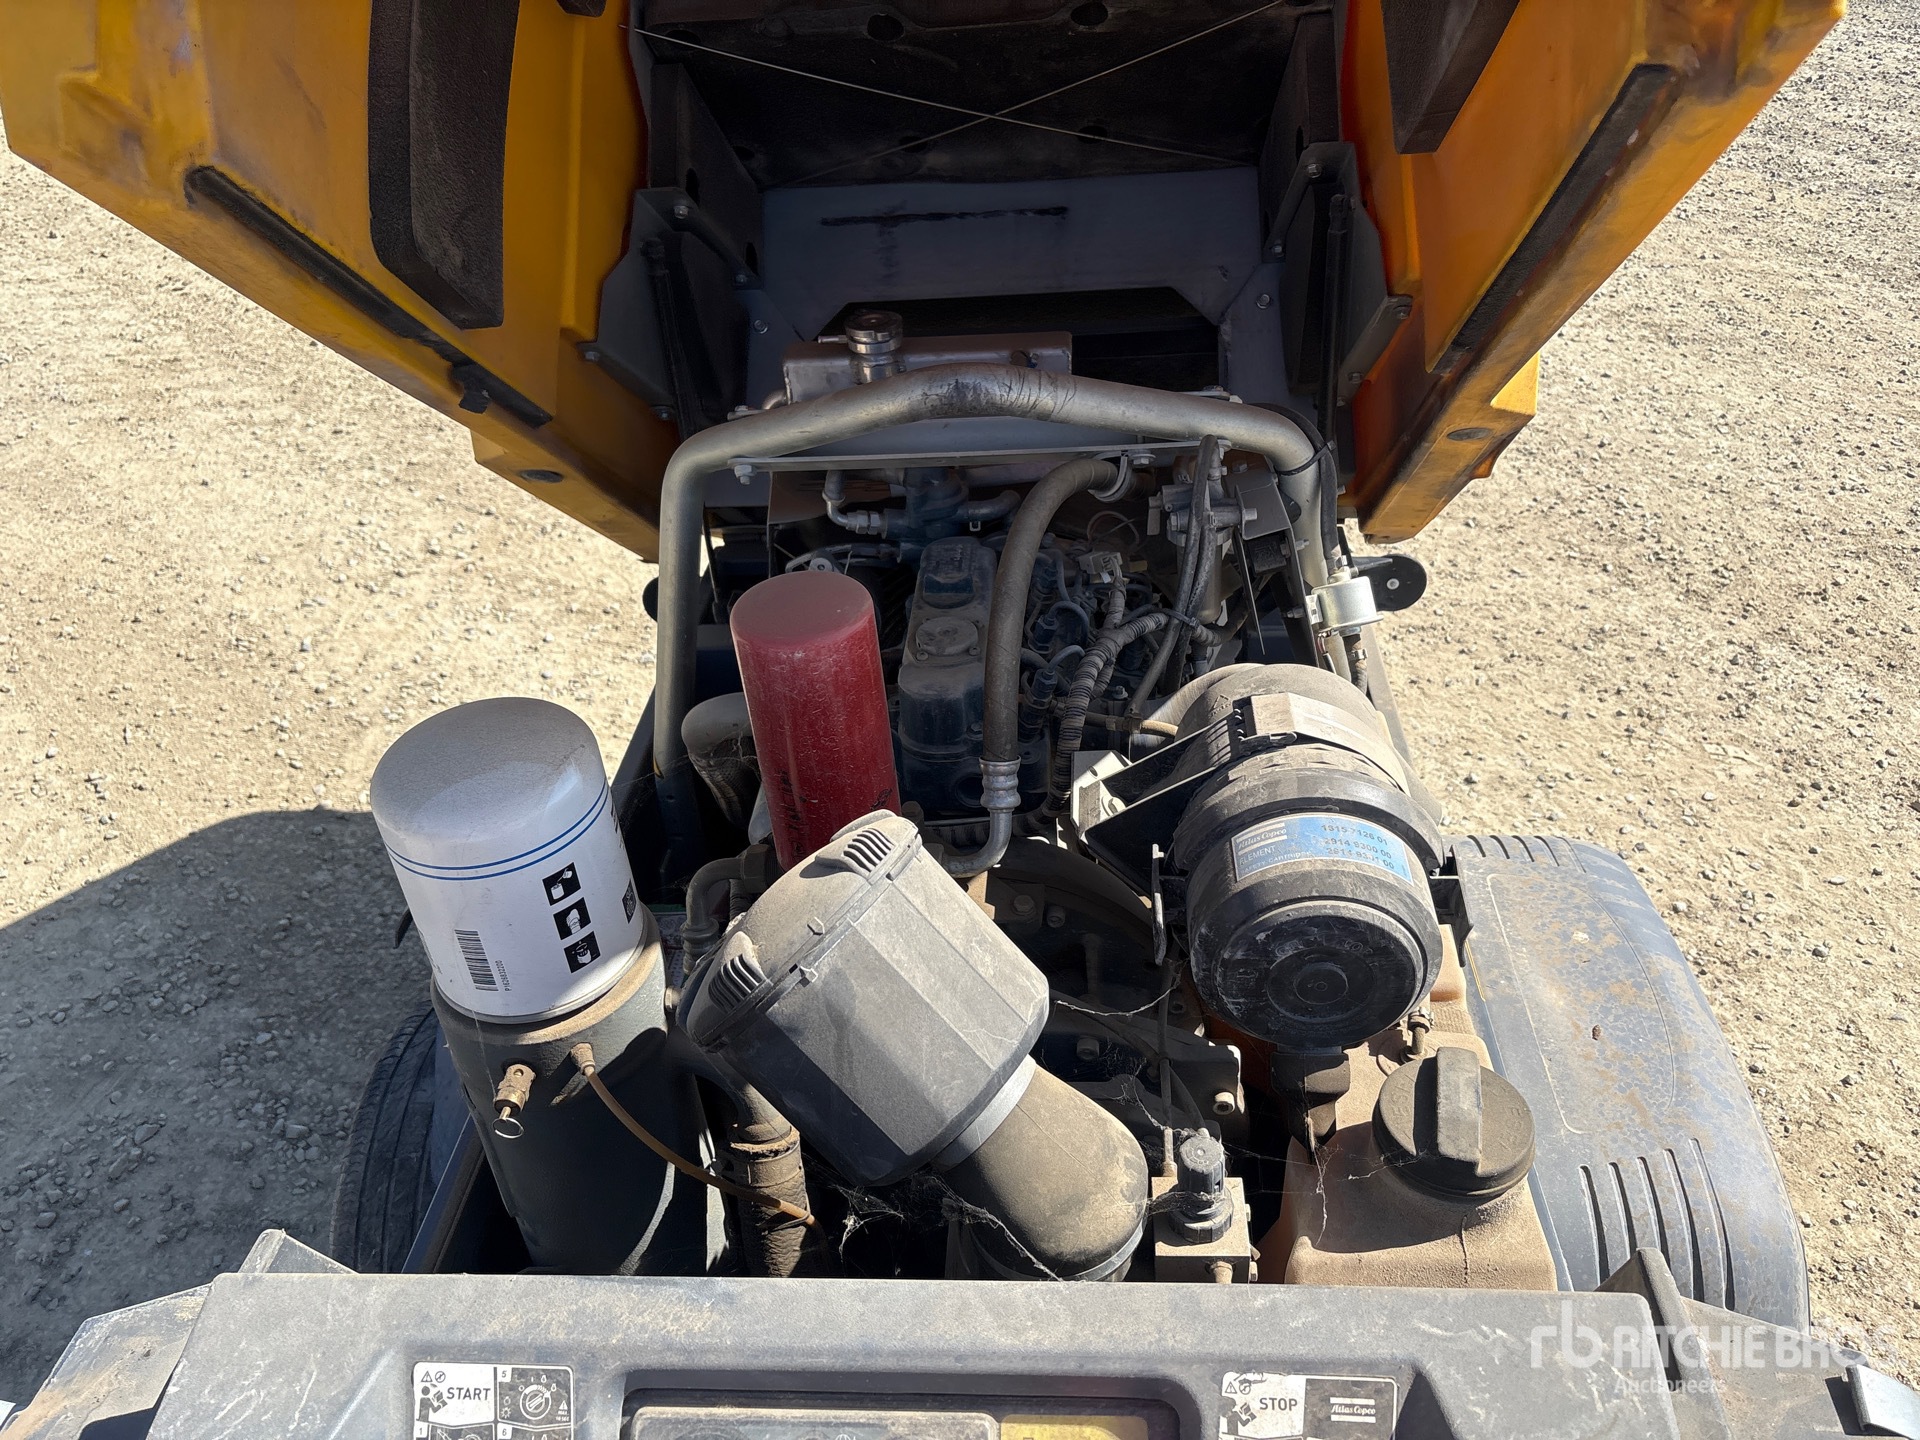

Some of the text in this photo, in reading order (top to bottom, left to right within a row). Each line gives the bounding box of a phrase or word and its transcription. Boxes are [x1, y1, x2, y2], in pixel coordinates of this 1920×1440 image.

[1261, 828, 1287, 841] Copco
[1321, 824, 1348, 833] 1315
[1376, 835, 1388, 846] 01
[1325, 837, 1351, 847] 2914
[1380, 849, 1392, 859] 00
[1239, 845, 1276, 866] ELEMENT
[1382, 859, 1395, 870] 00
[501, 1370, 507, 1379] 5
[446, 1387, 491, 1401] START
[1259, 1397, 1298, 1412] STOP
[1331, 1404, 1376, 1417] Atlas Copco
[502, 1428, 507, 1436] 6
